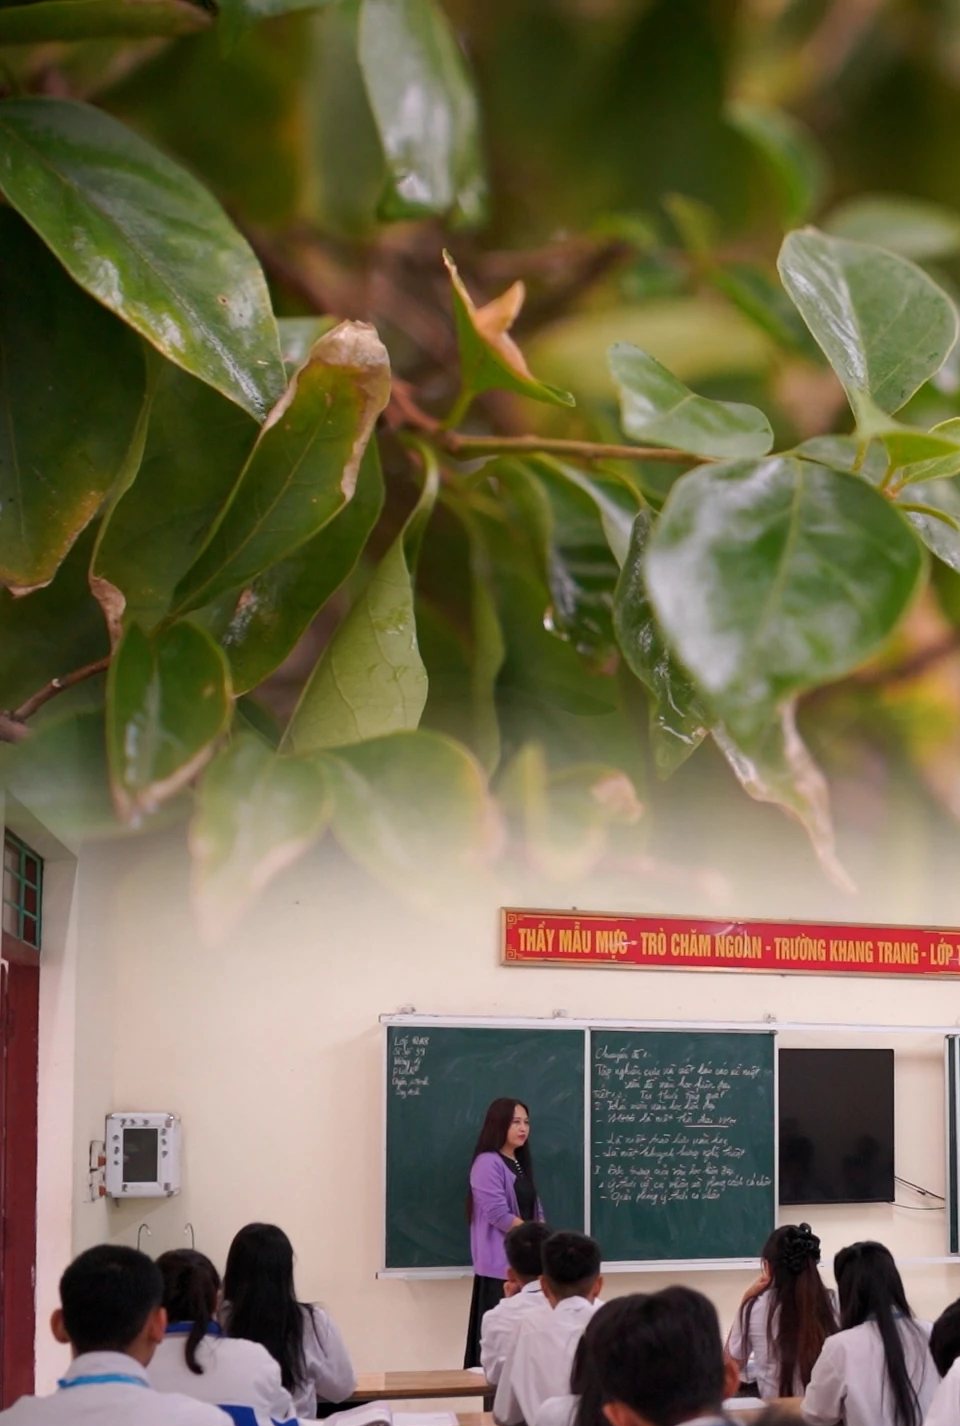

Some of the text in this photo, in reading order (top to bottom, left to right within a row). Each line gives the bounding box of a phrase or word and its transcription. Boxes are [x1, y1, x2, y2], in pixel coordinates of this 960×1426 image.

[518, 921, 555, 952] THẦY
[558, 921, 592, 953] MẪU
[596, 928, 628, 959] MỰC
[640, 925, 666, 956] TRÒ
[671, 928, 711, 957] CHĂM
[774, 932, 826, 961] TRƯỜNG
[830, 939, 873, 963] KHANG
[877, 941, 919, 964] TRANG
[930, 937, 953, 966] LỚP
